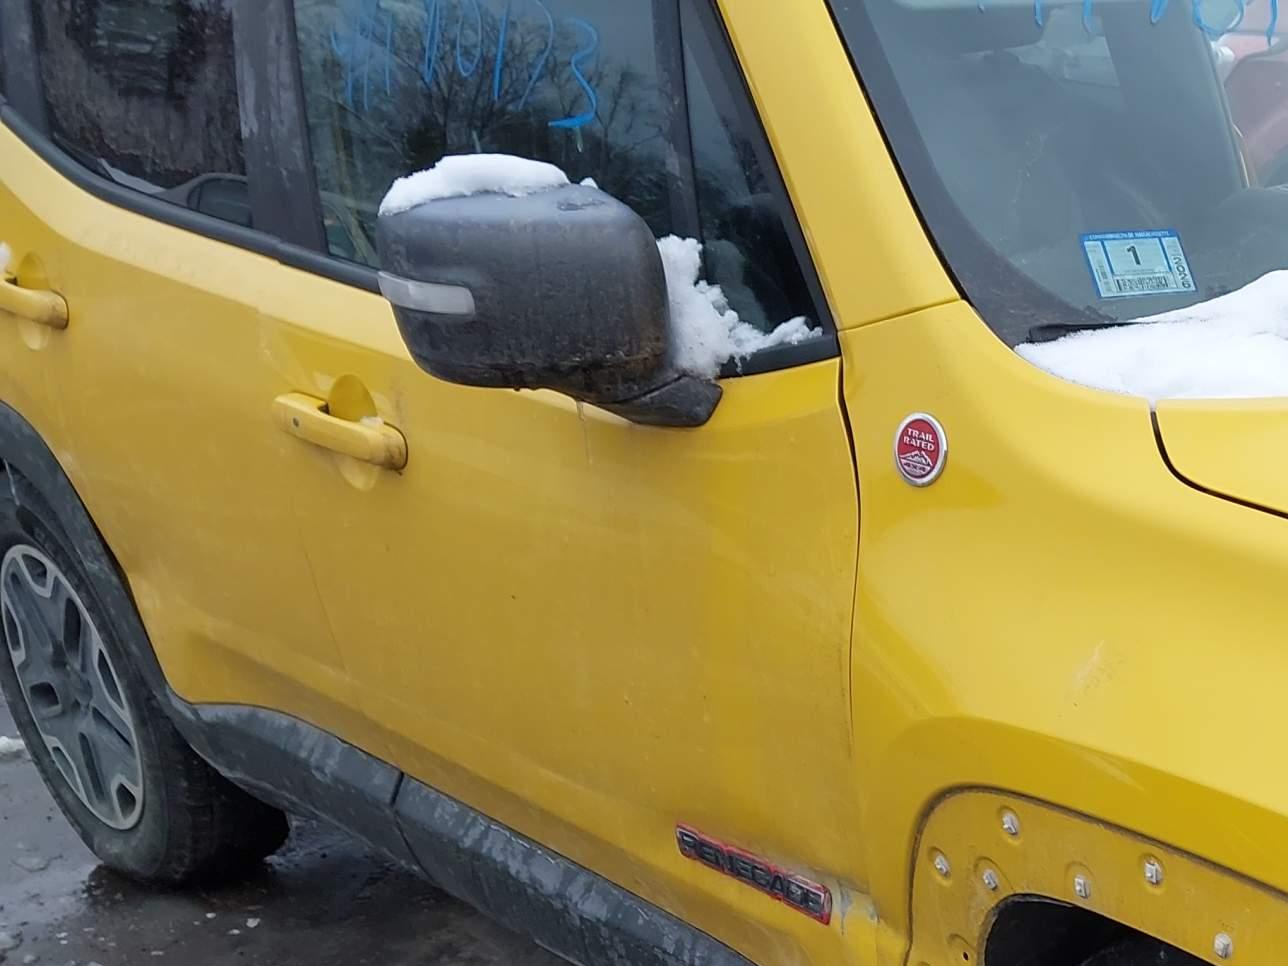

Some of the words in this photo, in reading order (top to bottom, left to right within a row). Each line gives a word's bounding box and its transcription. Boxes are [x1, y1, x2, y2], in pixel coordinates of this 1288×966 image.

[1126, 245, 1141, 266] 1
[1172, 256, 1192, 289] 2026
[903, 435, 935, 452] RATED
[906, 427, 935, 443] TRAIL
